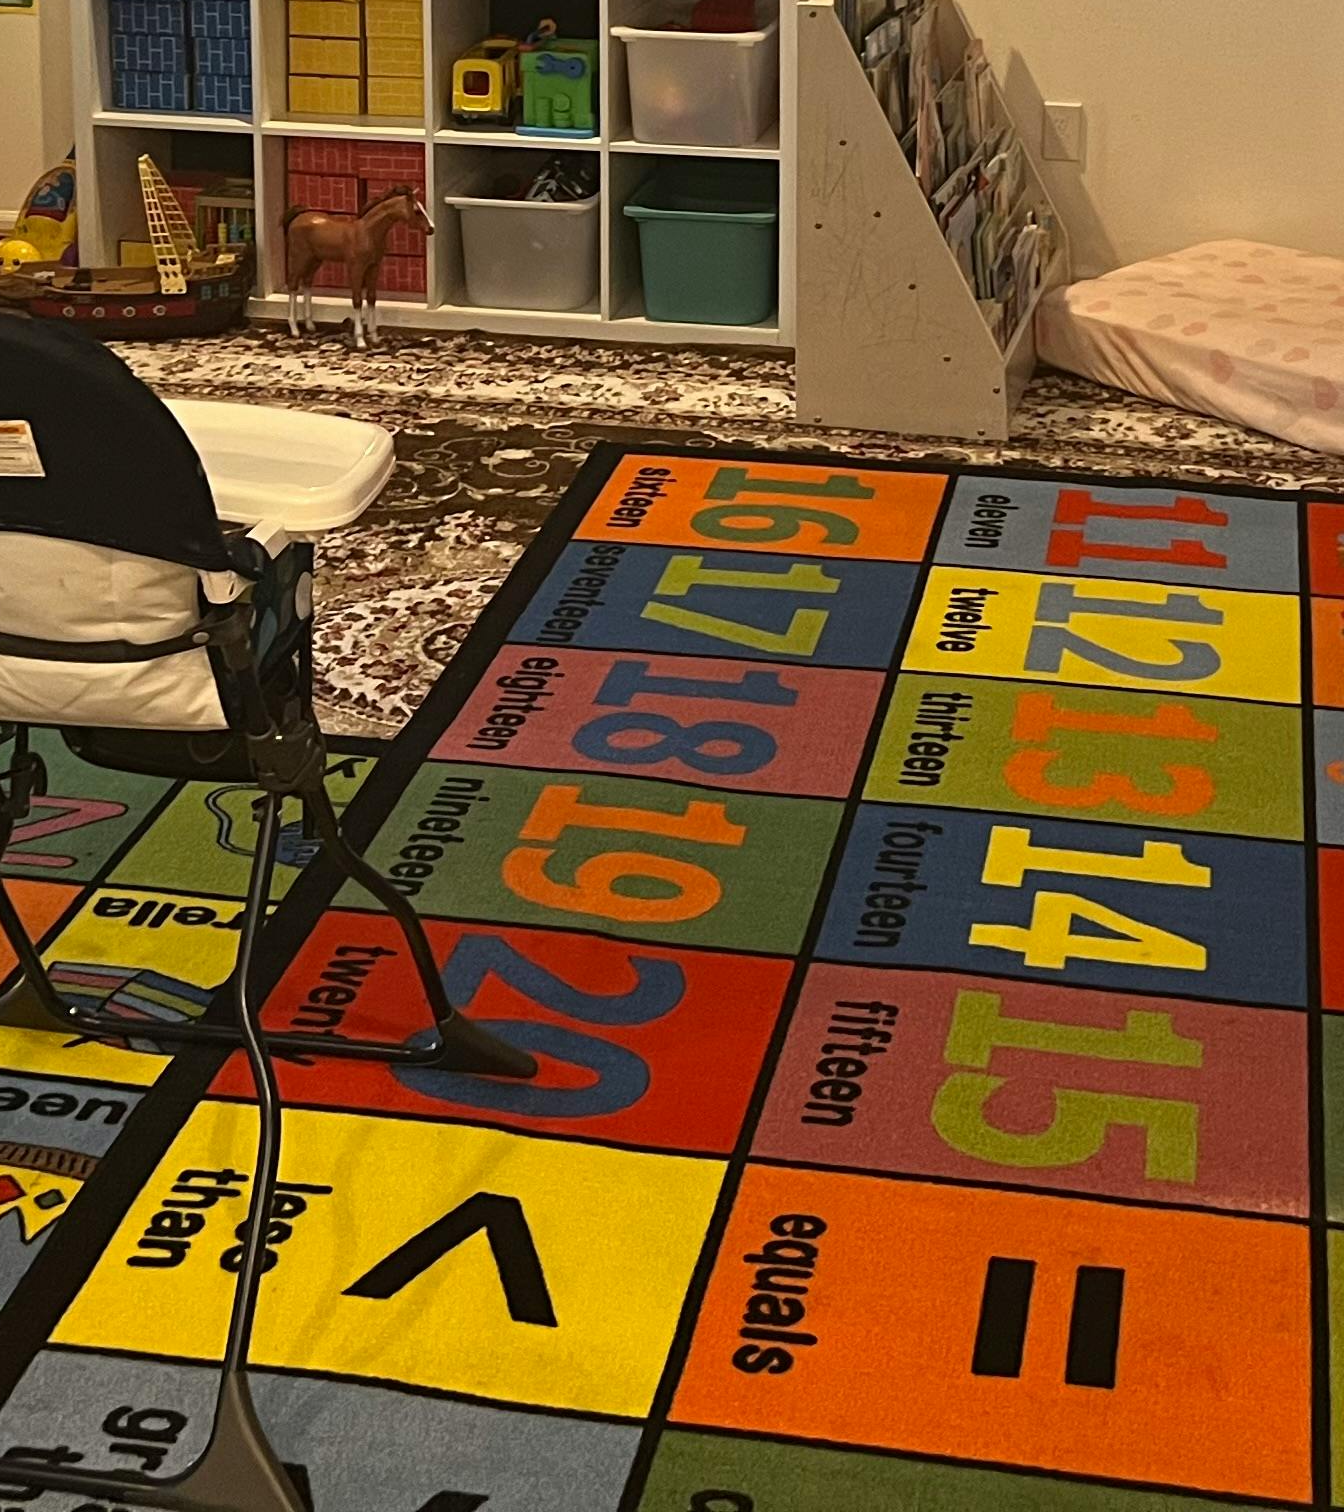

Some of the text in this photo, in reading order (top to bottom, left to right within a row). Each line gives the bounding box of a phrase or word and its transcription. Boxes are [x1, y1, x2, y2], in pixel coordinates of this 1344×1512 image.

[605, 466, 671, 530] sixteen
[689, 465, 876, 546] 16
[963, 493, 1019, 550] eleven
[1043, 489, 1230, 569] 11
[540, 544, 627, 645] seventeen
[639, 554, 842, 656] 17
[935, 587, 999, 654] twelve
[1022, 581, 1226, 682] 12
[465, 654, 566, 751] eighteen
[570, 659, 800, 776] 18
[896, 692, 975, 786] thirteen
[1003, 692, 1219, 818] 13
[387, 776, 491, 898] nineteen
[501, 783, 748, 924] 19
[852, 820, 945, 949] fourteen
[967, 825, 1212, 972] 14
[393, 934, 688, 1117] 20
[801, 999, 900, 1128] fifteen
[931, 988, 1205, 1183] 15
[126, 1167, 250, 1270] than
[731, 1213, 828, 1375] equals
